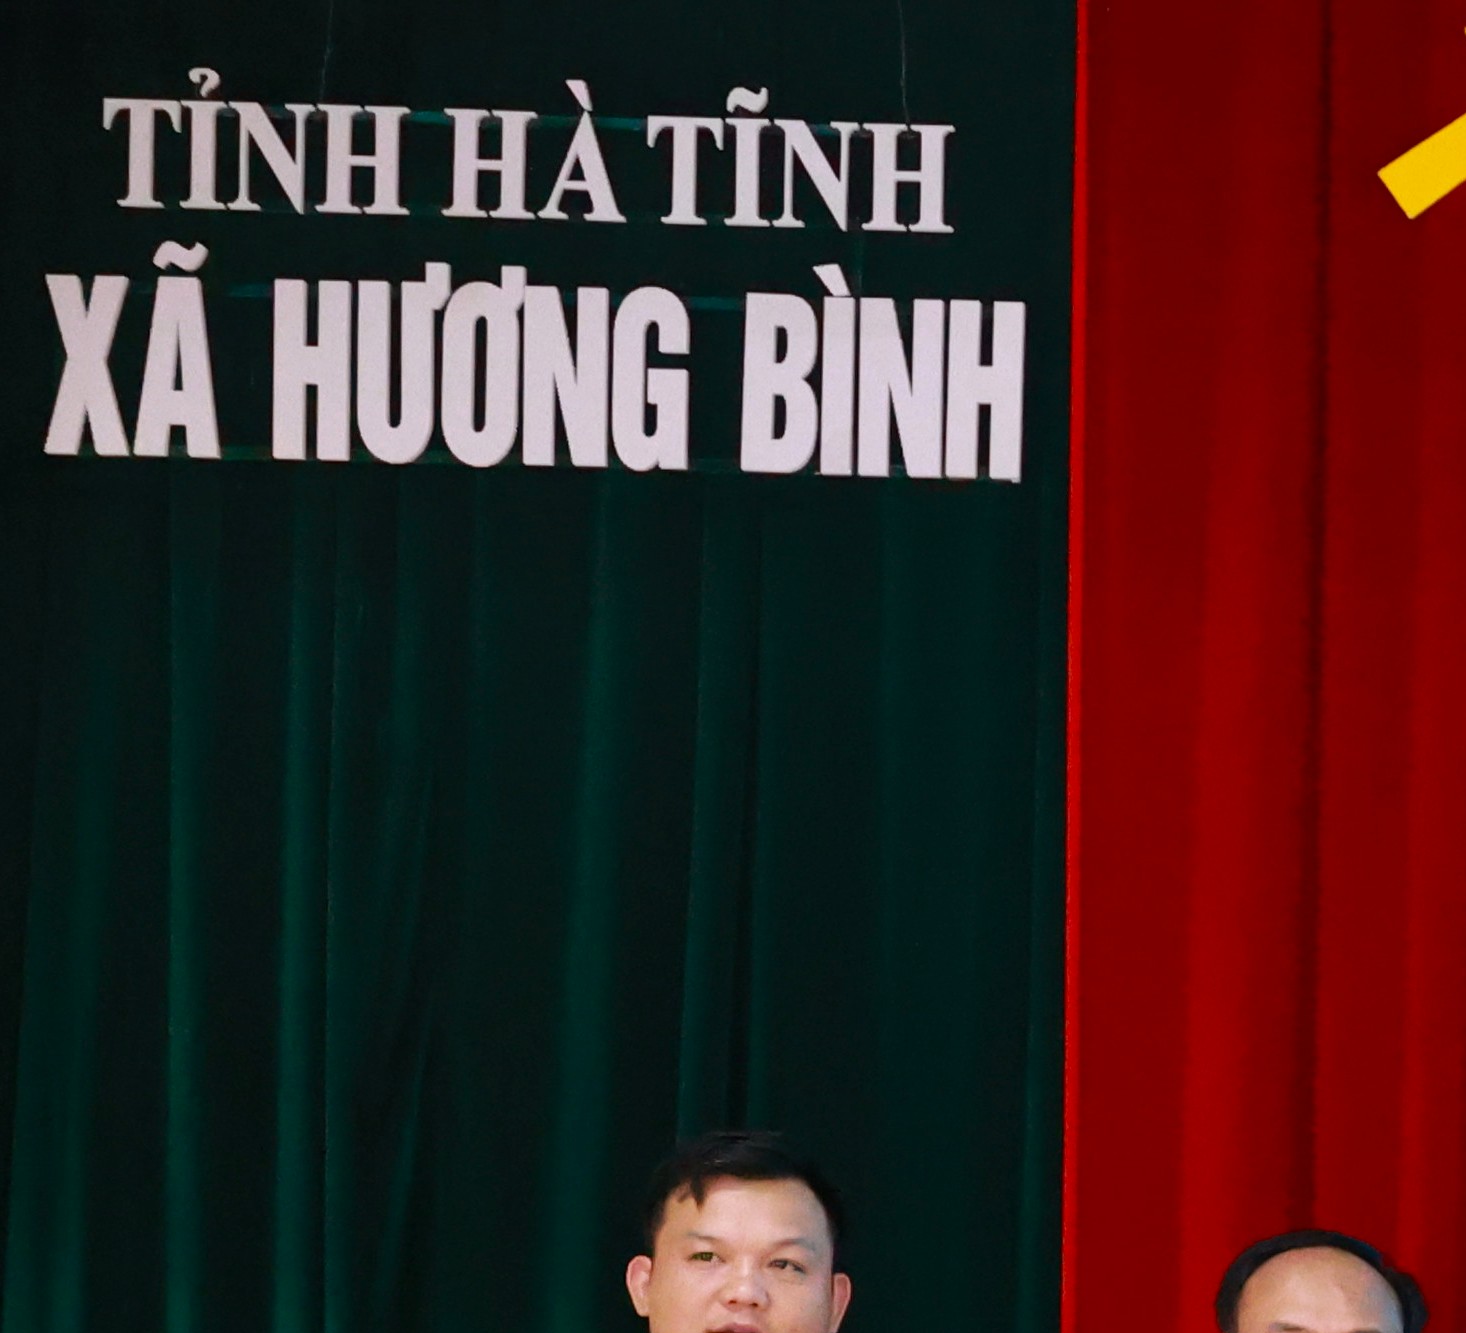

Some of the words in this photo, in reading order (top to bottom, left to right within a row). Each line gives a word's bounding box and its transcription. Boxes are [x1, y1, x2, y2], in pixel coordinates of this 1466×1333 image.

[101, 67, 410, 216] TỈNH
[441, 80, 627, 223] HÀ
[646, 86, 955, 233] TĨNH
[44, 240, 221, 459] XÃ
[272, 261, 691, 472] HƯƠNG
[739, 264, 1027, 483] BÌNH
